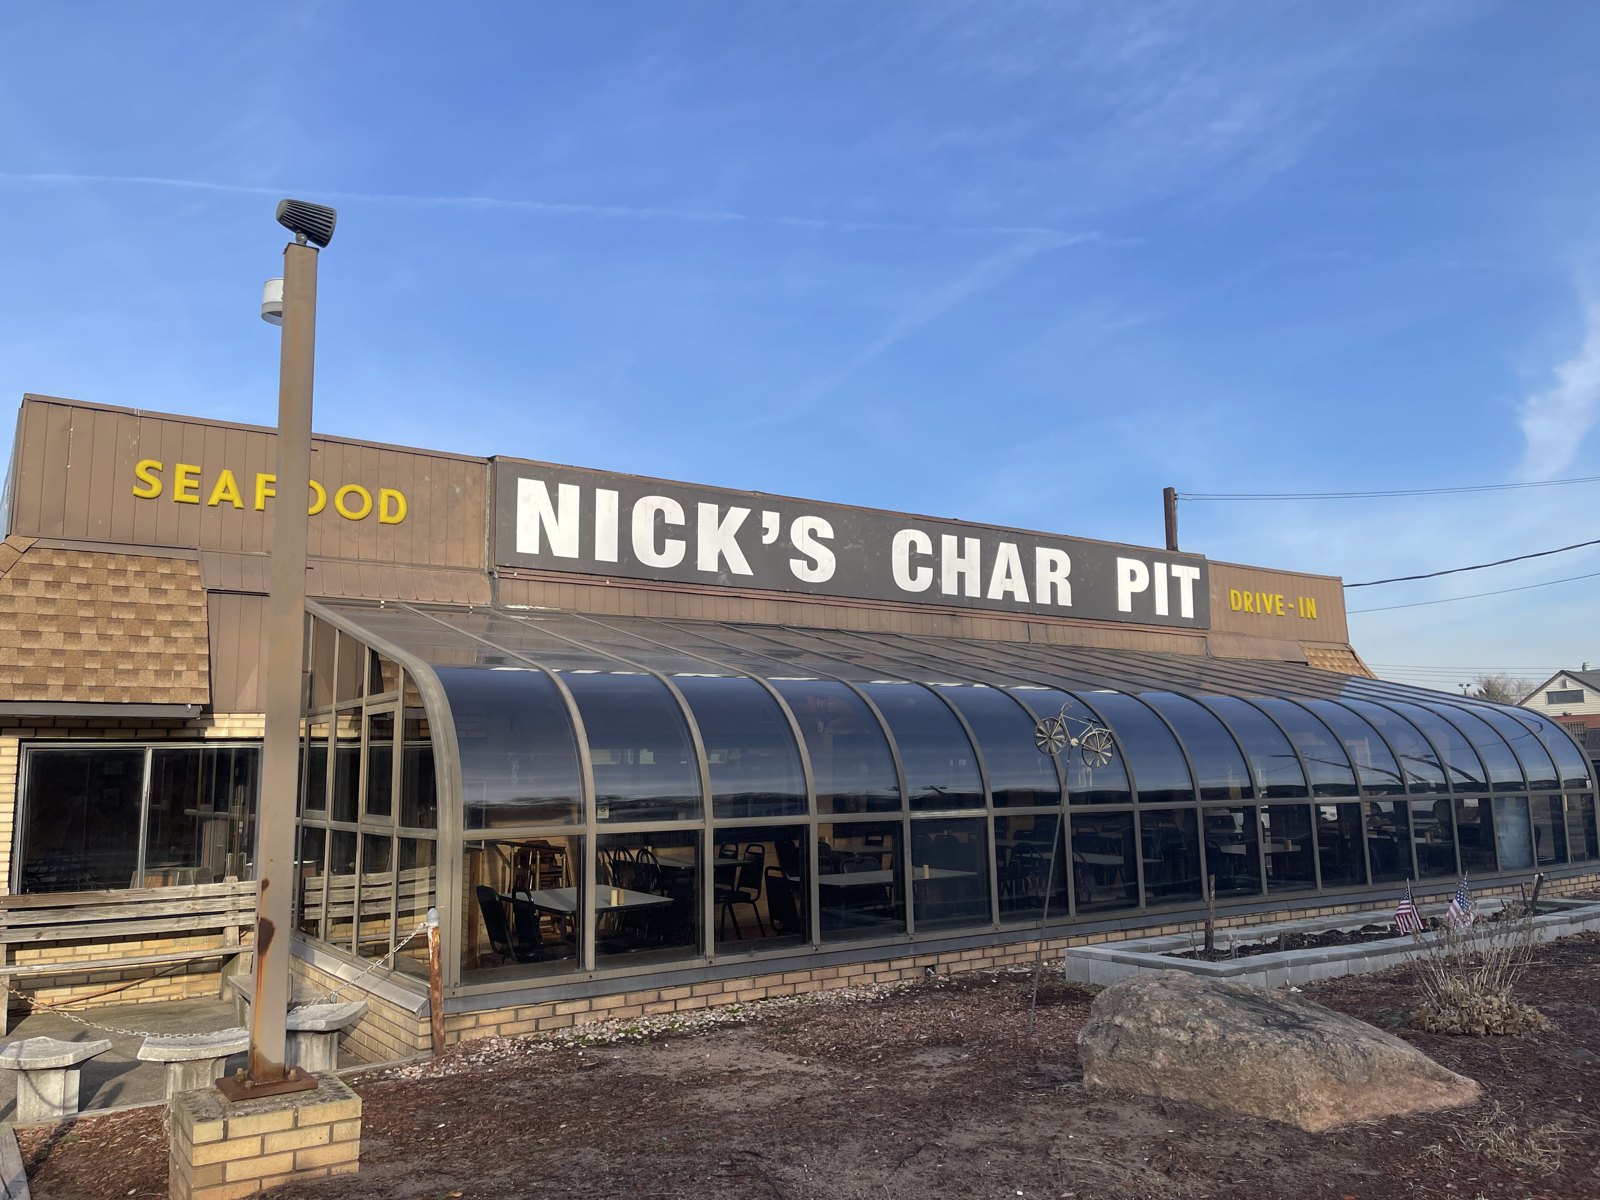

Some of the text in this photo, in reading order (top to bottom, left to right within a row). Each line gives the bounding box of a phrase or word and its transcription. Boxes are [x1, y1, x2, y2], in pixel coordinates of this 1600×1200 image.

[516, 477, 1201, 619] NICK'S CHAR PIT
